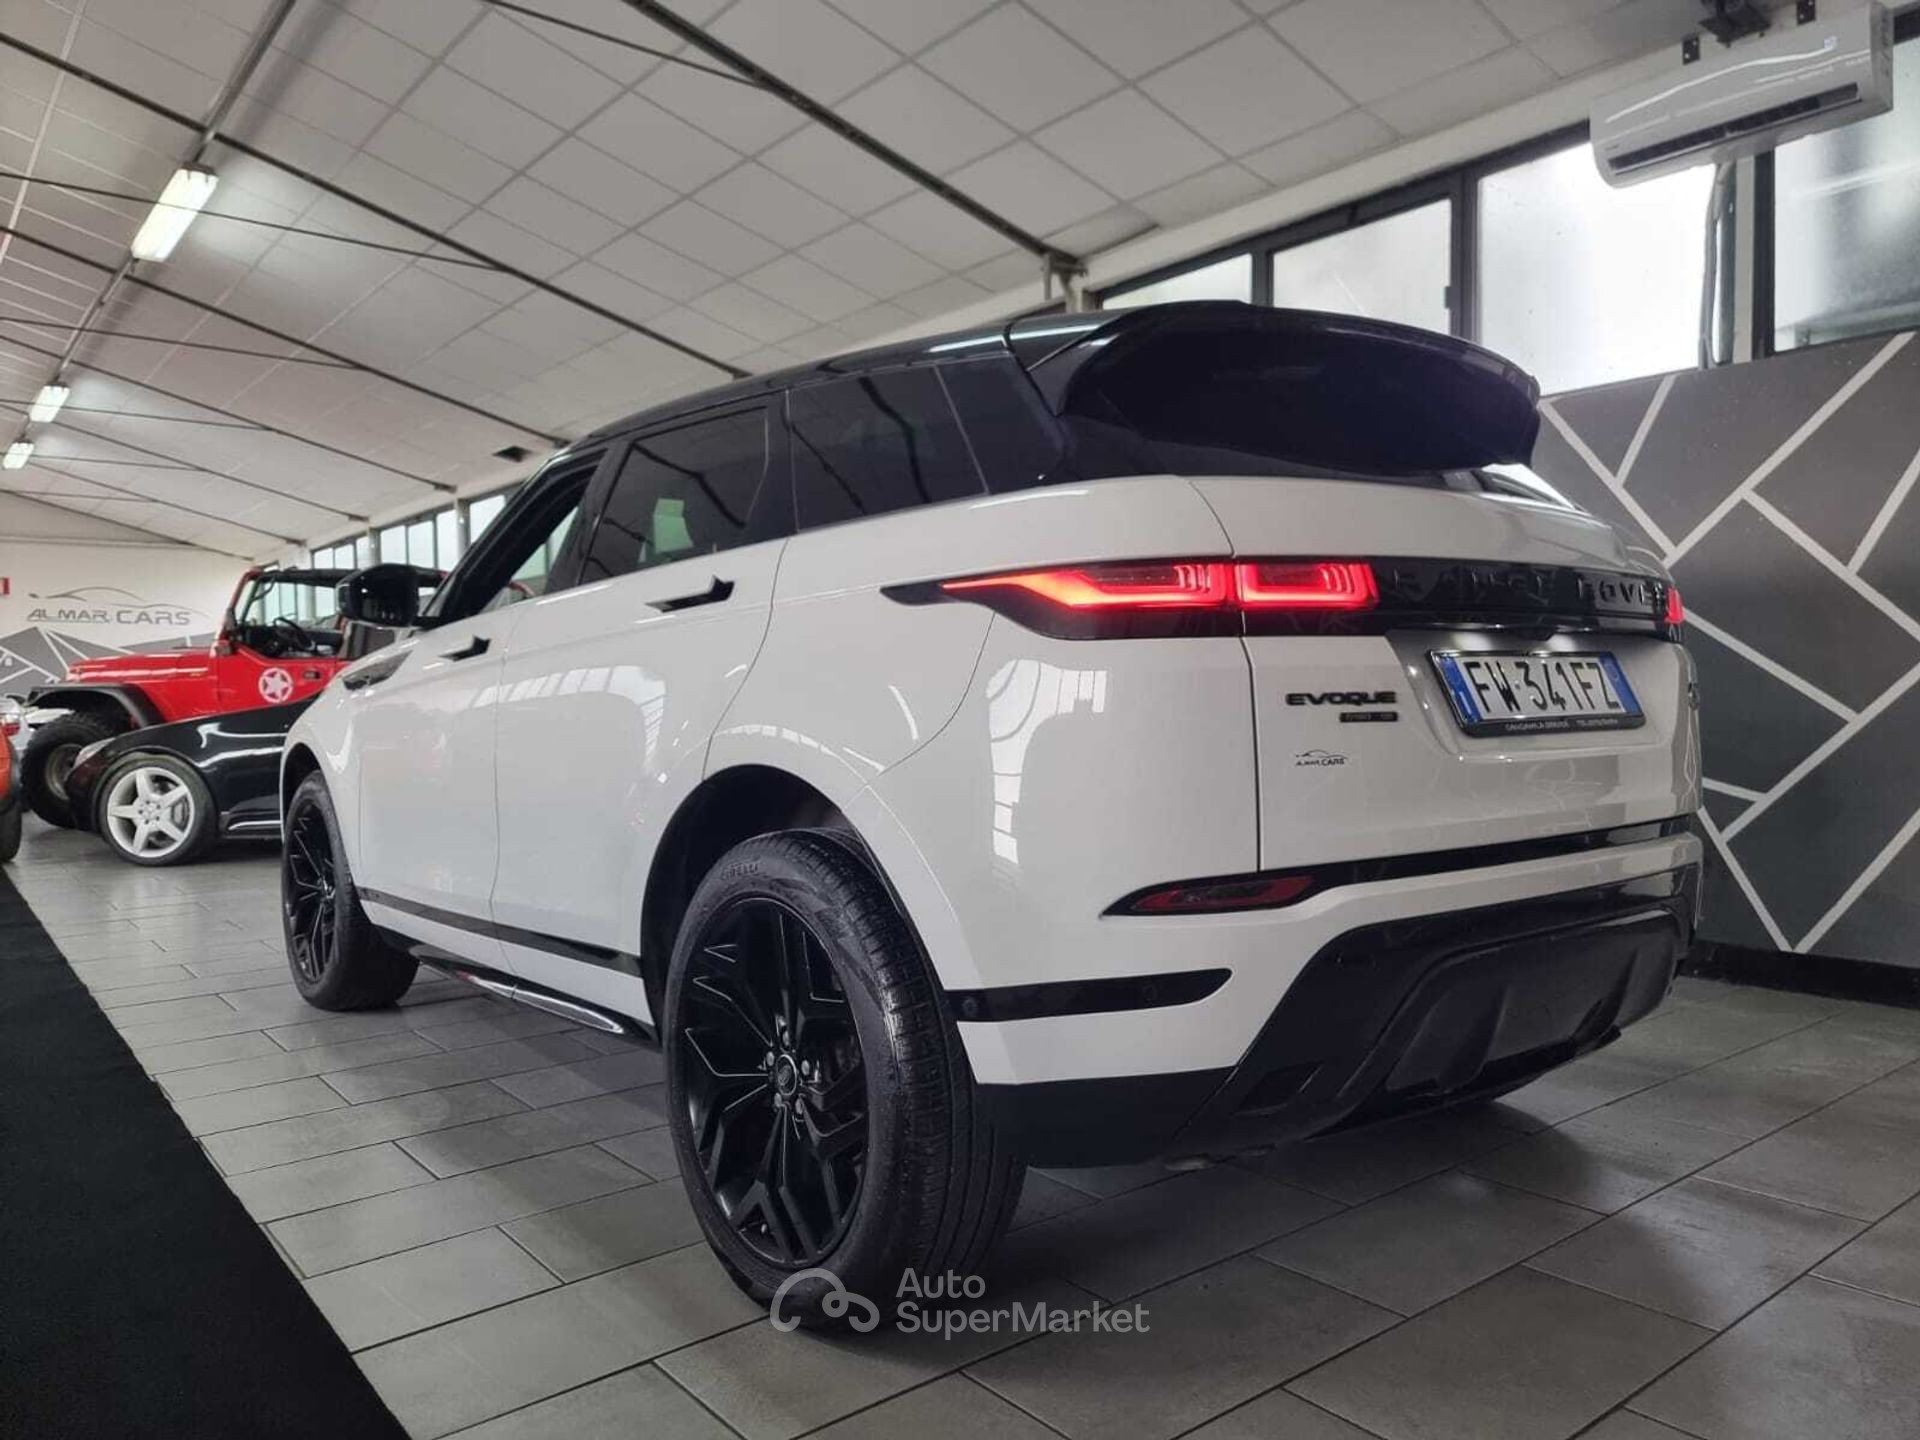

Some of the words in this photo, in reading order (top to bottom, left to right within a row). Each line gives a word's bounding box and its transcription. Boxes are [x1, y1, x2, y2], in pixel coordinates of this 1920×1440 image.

[28, 608, 107, 622] ALMAR
[116, 609, 191, 626] CARS
[1285, 691, 1397, 706] EVOQUE
